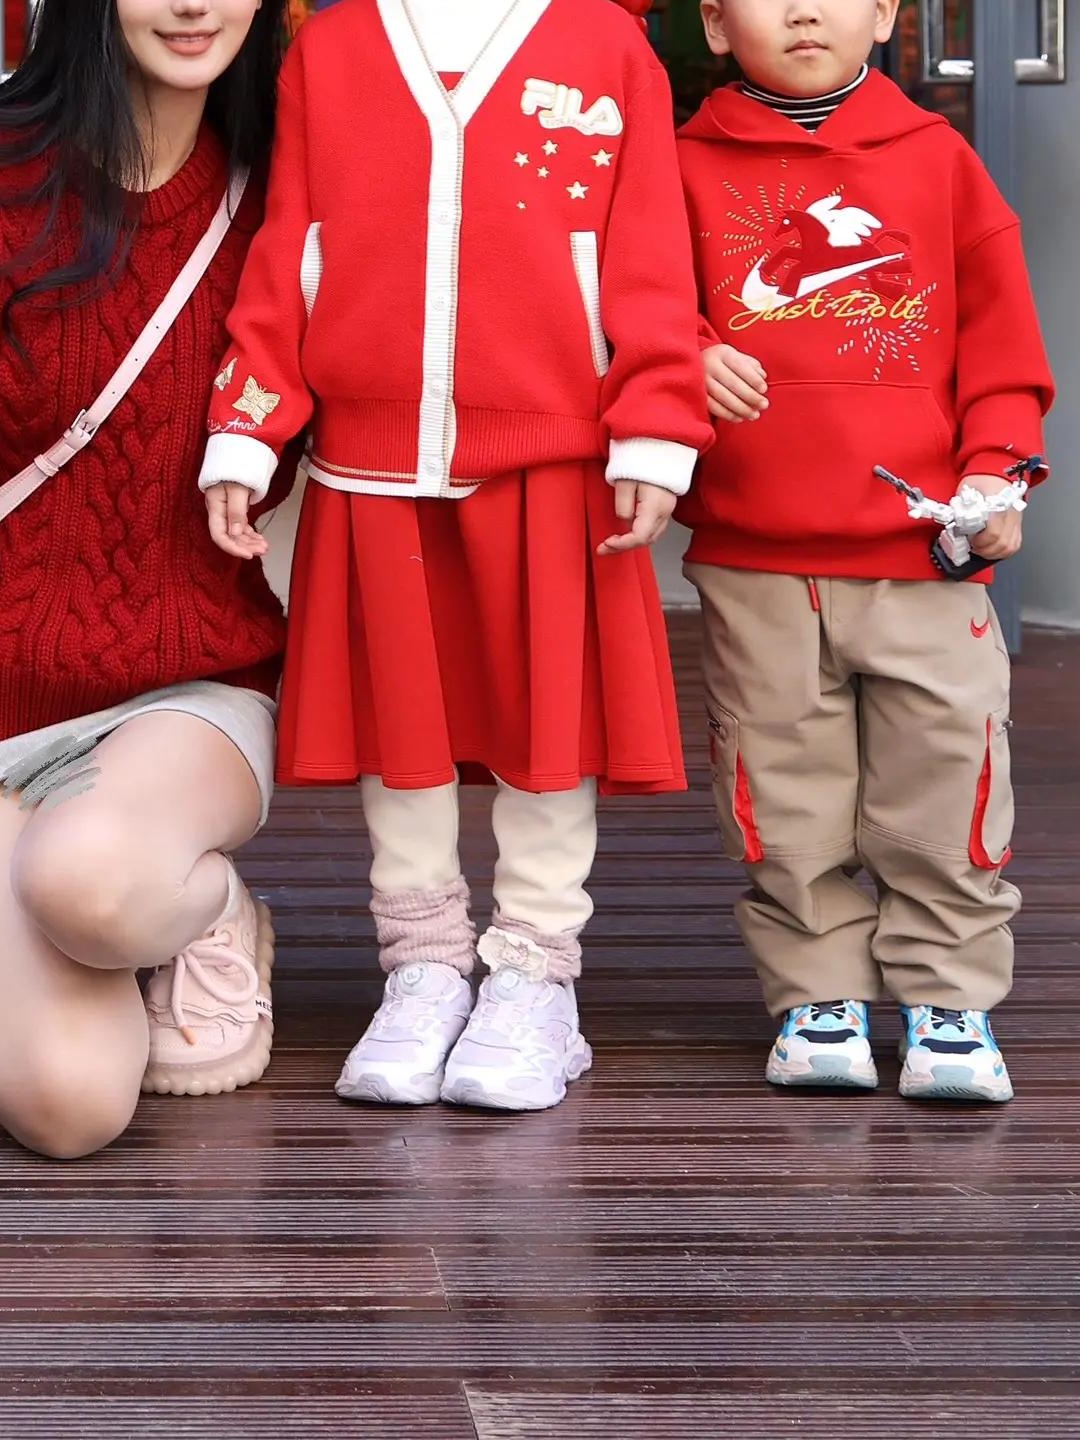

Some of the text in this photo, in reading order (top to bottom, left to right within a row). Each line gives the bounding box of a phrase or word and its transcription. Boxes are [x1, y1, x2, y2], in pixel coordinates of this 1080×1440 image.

[521, 78, 623, 136] FILA
[728, 289, 827, 330] Just
[825, 293, 886, 319] Do
